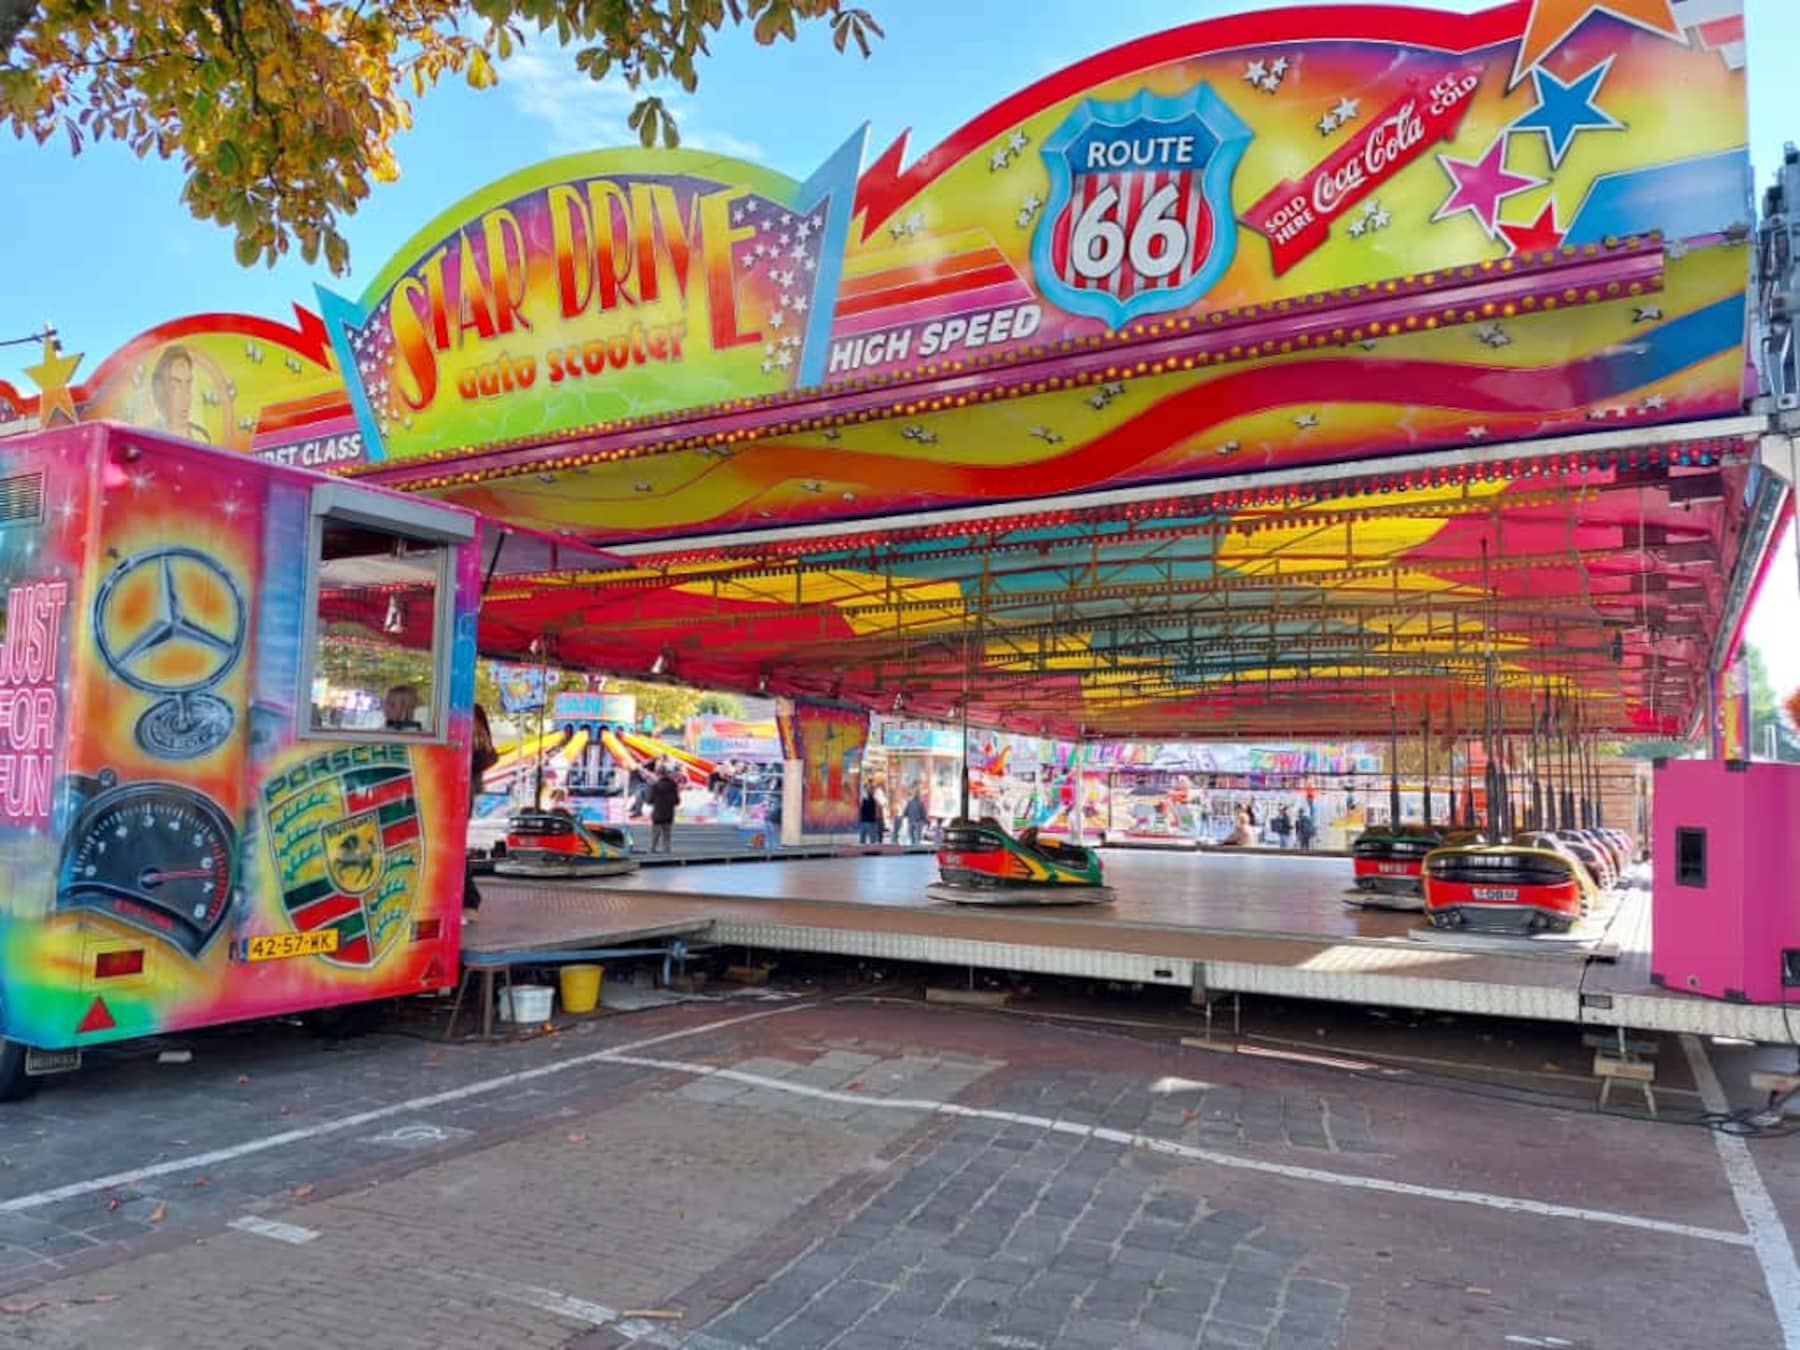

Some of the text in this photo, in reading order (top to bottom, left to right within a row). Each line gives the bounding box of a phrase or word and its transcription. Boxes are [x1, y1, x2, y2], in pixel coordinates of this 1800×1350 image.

[1429, 73, 1457, 100] ICE
[1430, 75, 1478, 115] COLD
[1087, 136, 1195, 168] ROUTE
[1072, 182, 1187, 278] 66
[1265, 196, 1306, 233] SOLD
[1275, 210, 1316, 245] HERE
[389, 179, 763, 411] STAR DRIVE
[829, 304, 1042, 373] HIGH SPEED
[457, 320, 683, 400] auto scooter
[302, 433, 362, 466] CLASS
[264, 743, 407, 801] PORSCHE
